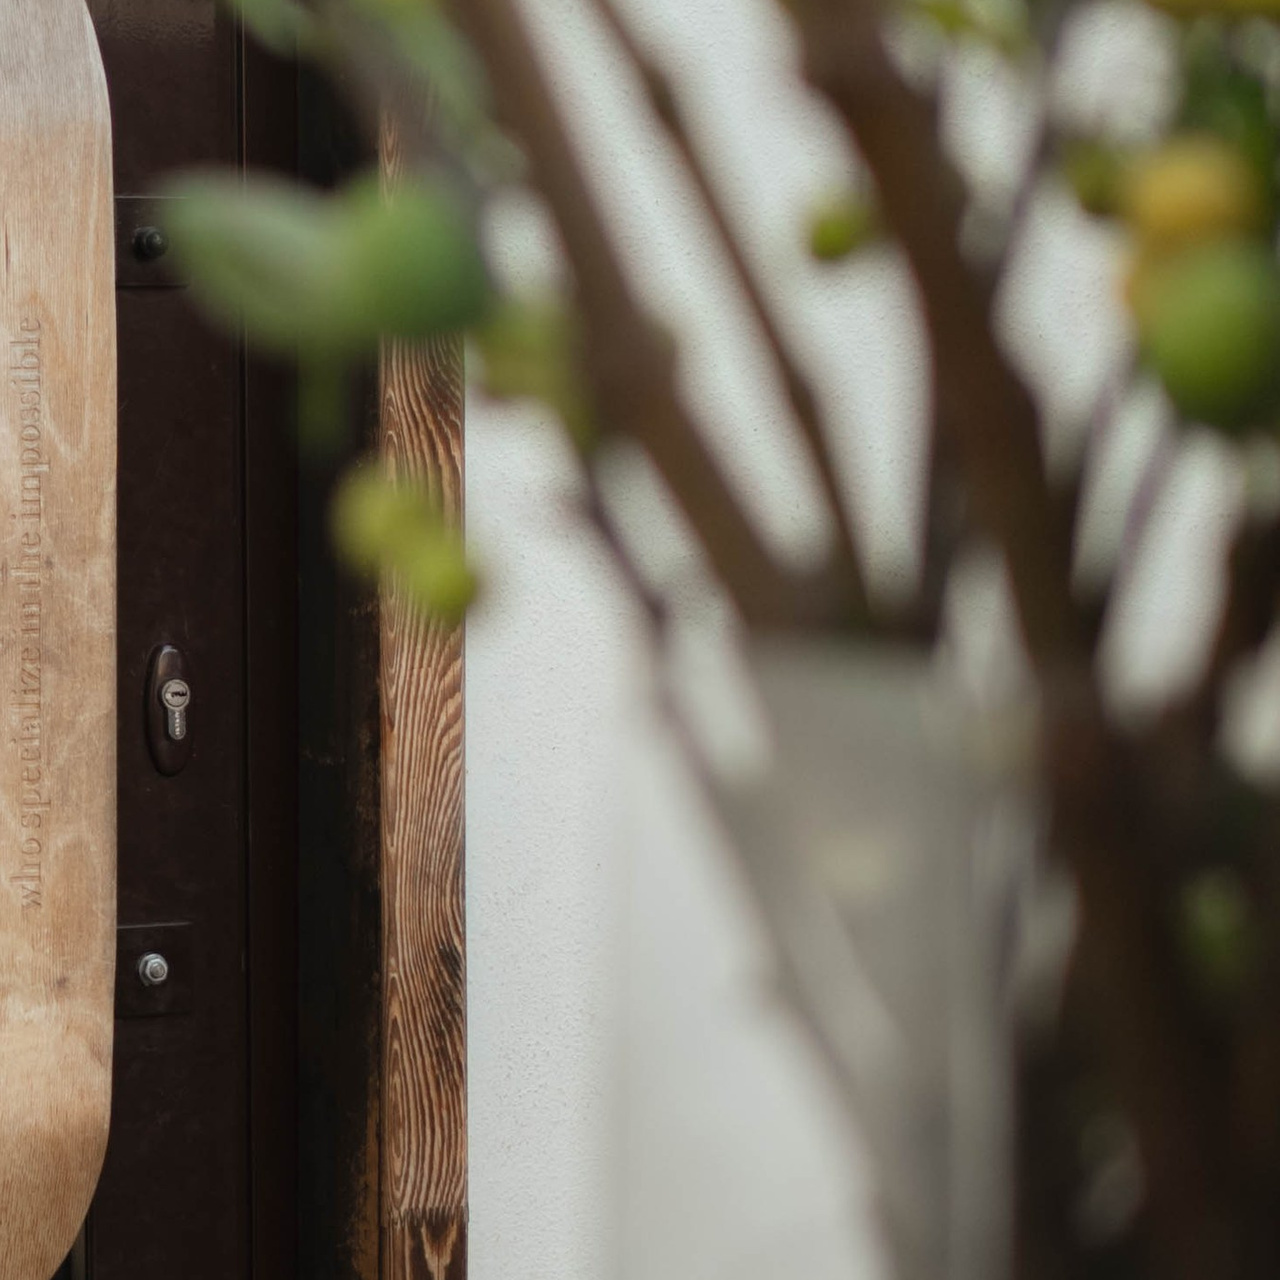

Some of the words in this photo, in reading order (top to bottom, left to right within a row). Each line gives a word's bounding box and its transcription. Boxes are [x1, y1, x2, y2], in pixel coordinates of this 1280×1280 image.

[9, 317, 52, 524] impossible
[9, 533, 43, 591] the
[9, 604, 43, 637] in
[9, 646, 52, 829] specialize
[9, 837, 43, 911] who
